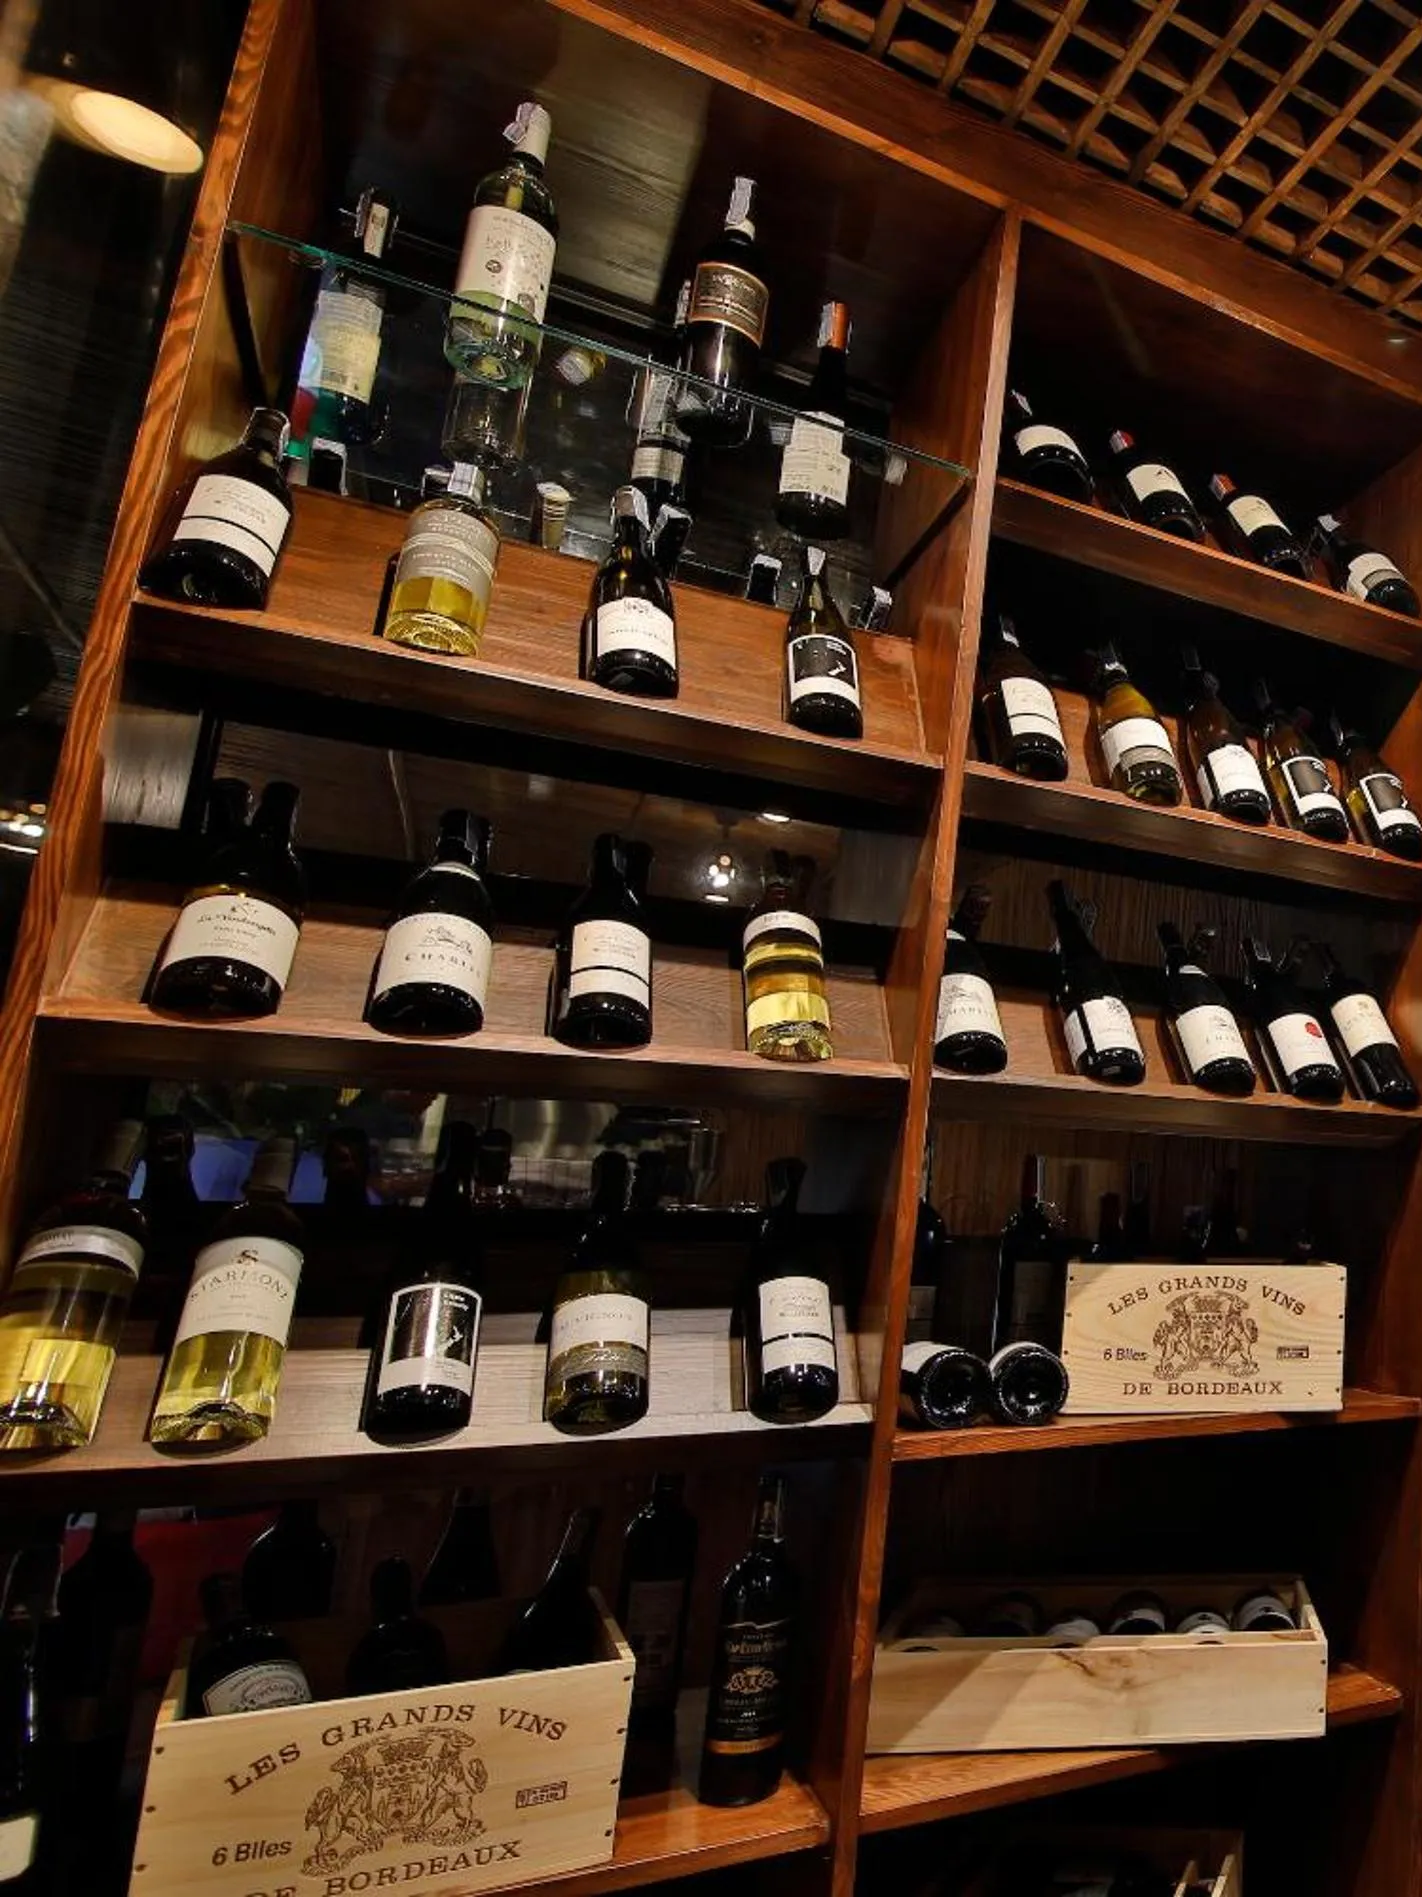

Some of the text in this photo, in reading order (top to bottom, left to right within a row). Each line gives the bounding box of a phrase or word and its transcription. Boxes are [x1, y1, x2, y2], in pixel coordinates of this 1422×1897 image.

[1107, 1275, 1306, 1316] LES GRANDS VINS
[1103, 1349, 1113, 1361] 6
[1122, 1381, 1284, 1396] DE BORDEAUX
[225, 1704, 568, 1795] LES GRANDS VINS
[211, 1846, 228, 1867] 6
[323, 1839, 523, 1897] BORDEAUX
